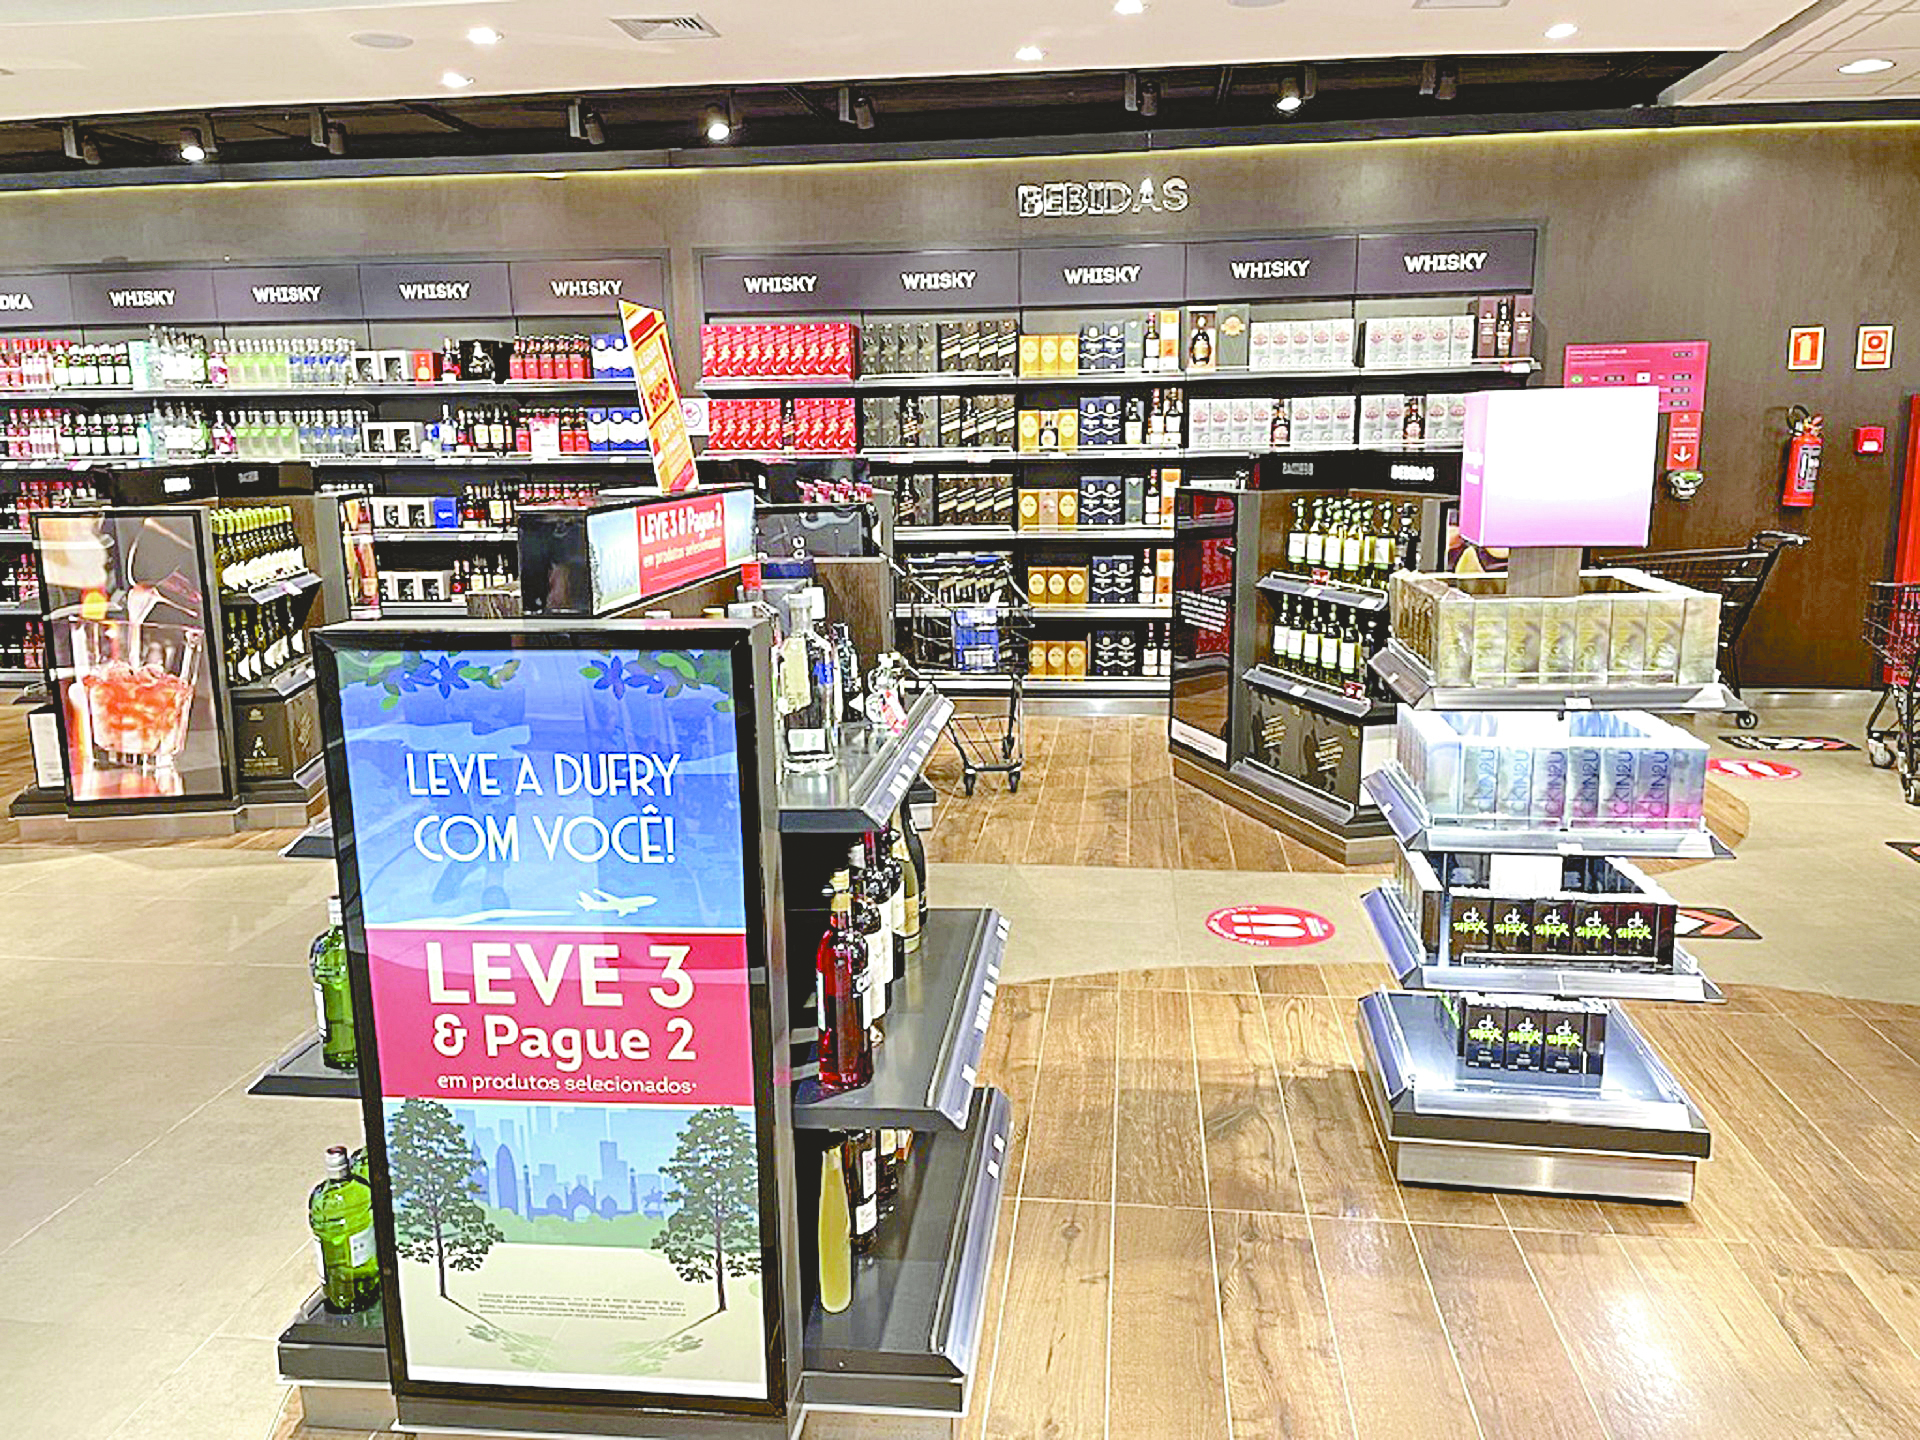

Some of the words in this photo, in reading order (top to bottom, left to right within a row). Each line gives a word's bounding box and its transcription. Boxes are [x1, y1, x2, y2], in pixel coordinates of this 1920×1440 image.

[1017, 177, 1189, 217] BEBIDAS
[1231, 260, 1311, 279] WHISKY
[1403, 252, 1487, 273] WHISKY
[743, 275, 817, 294] WHISKY
[901, 271, 976, 290] WHISKY
[1064, 266, 1141, 285] WHISKY
[108, 289, 176, 307] WHISKY
[252, 286, 321, 304] WHISKY
[398, 282, 470, 300] WHISKY
[550, 280, 624, 298] WHISKY
[640, 510, 670, 545] LEVE
[669, 509, 677, 538] 3
[686, 505, 716, 540] Pague
[715, 501, 723, 527] 2
[406, 752, 499, 797] LEVE
[514, 753, 544, 797] A
[553, 752, 682, 798] DUFRY
[413, 814, 520, 863] COM
[532, 803, 677, 864] VOCÊ!
[425, 941, 625, 1007] LEVE
[648, 944, 695, 1009] 3
[433, 1013, 468, 1057] &
[484, 1013, 651, 1072] Pague
[666, 1017, 697, 1061] 2
[437, 1075, 468, 1089] em
[472, 1073, 561, 1093] produtos
